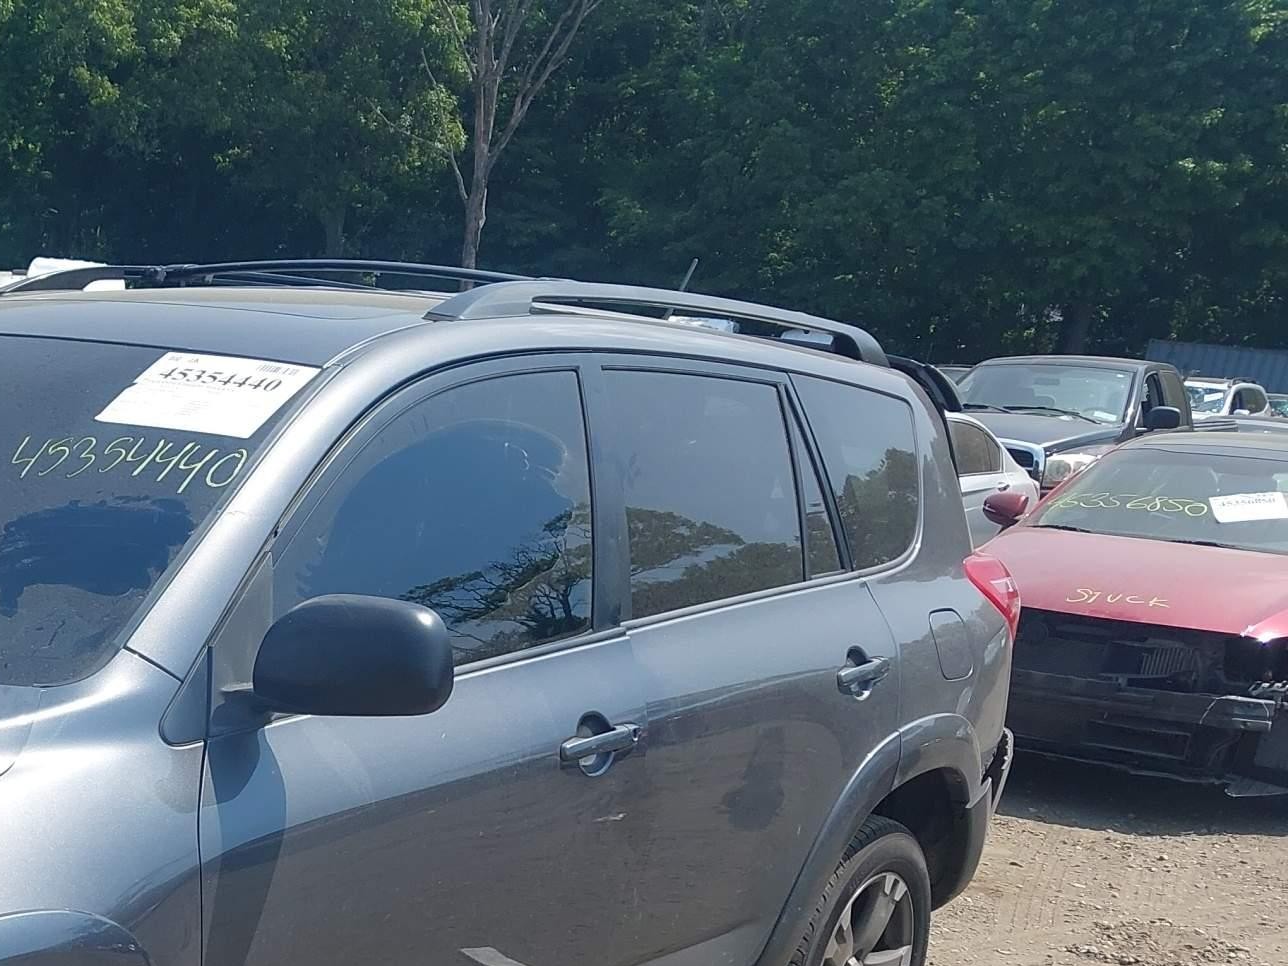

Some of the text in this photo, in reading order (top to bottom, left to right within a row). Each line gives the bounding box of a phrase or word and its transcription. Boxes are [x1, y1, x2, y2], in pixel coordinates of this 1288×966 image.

[159, 367, 283, 392] 45354440
[11, 434, 249, 494] 45354440
[1066, 588, 1169, 609] STUCK
